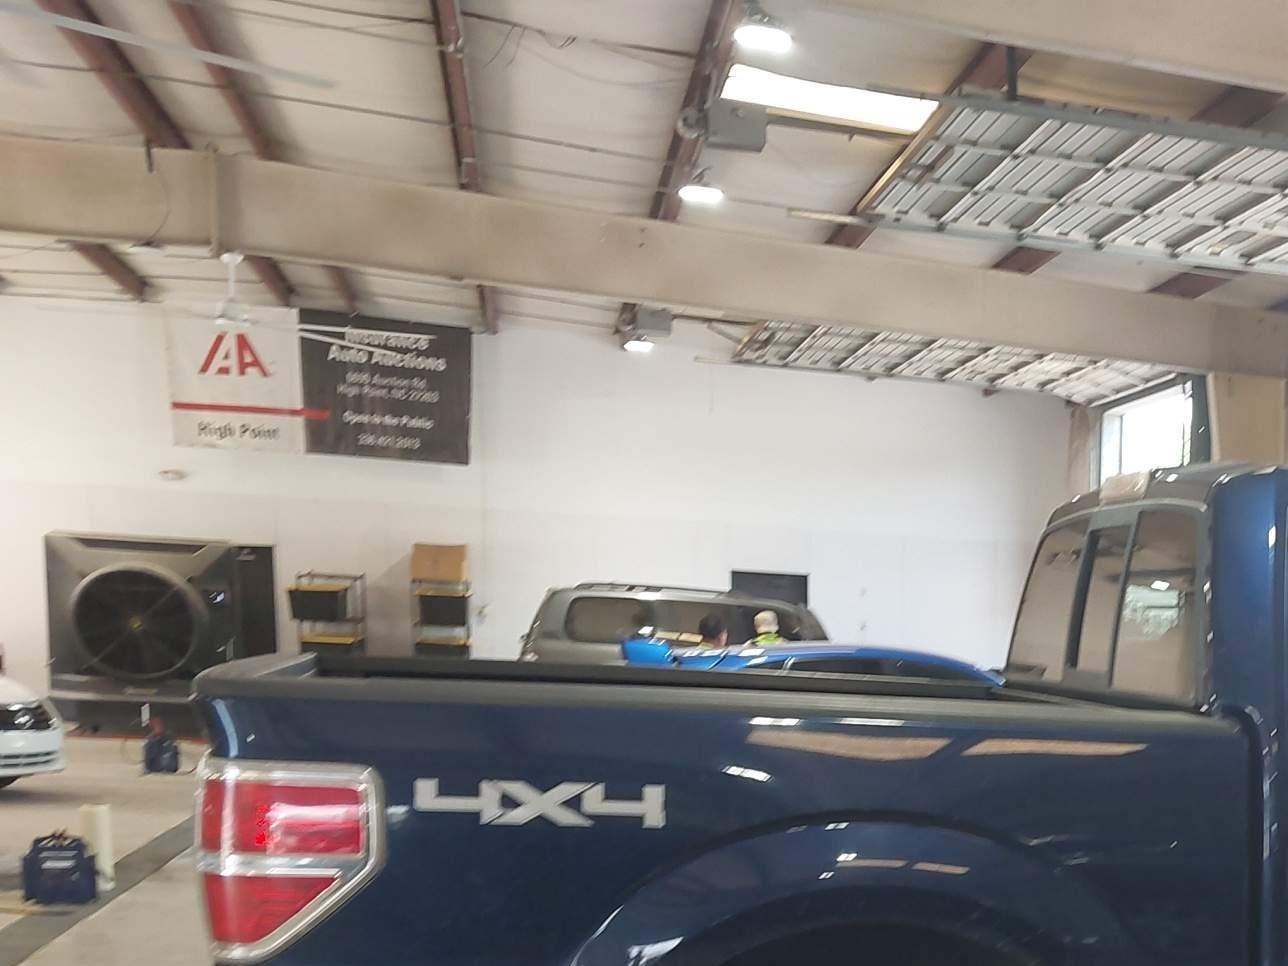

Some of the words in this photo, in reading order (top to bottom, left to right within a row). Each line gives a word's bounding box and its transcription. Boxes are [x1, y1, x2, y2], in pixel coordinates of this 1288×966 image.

[327, 344, 369, 363] Auto
[371, 351, 447, 372] Auctions
[197, 421, 236, 440] High
[239, 424, 281, 440] Point
